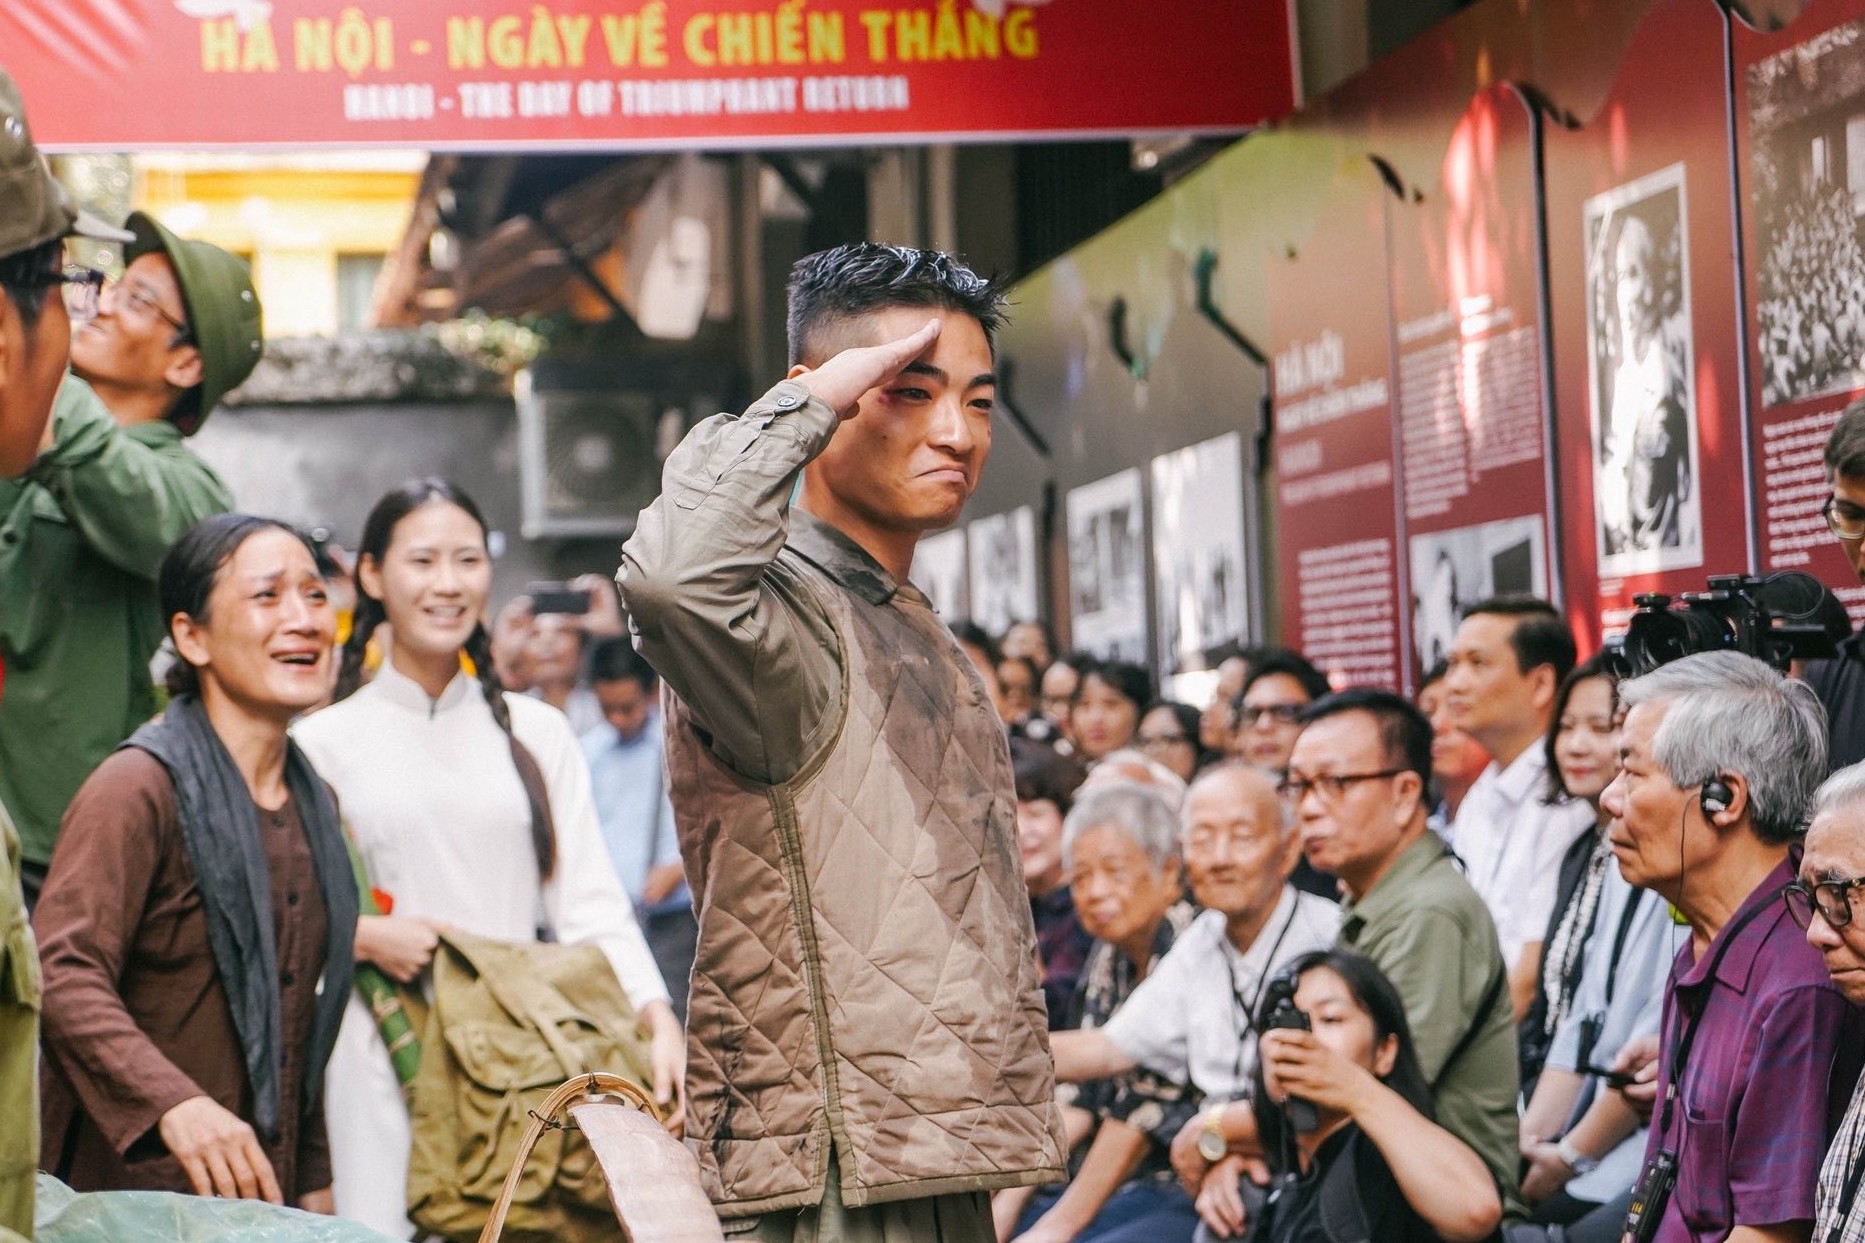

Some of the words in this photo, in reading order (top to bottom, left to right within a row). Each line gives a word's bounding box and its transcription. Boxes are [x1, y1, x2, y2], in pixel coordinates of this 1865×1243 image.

[293, 7, 394, 78] NỘI
[446, 4, 592, 71] NGÀY
[600, 0, 669, 68] VỀ
[342, 82, 434, 121] HANOI
[456, 81, 513, 119] THE
[516, 80, 572, 118] DAY
[576, 79, 614, 117] OF
[617, 77, 798, 117] TRIUMPHANT
[802, 75, 909, 112] RETURN
